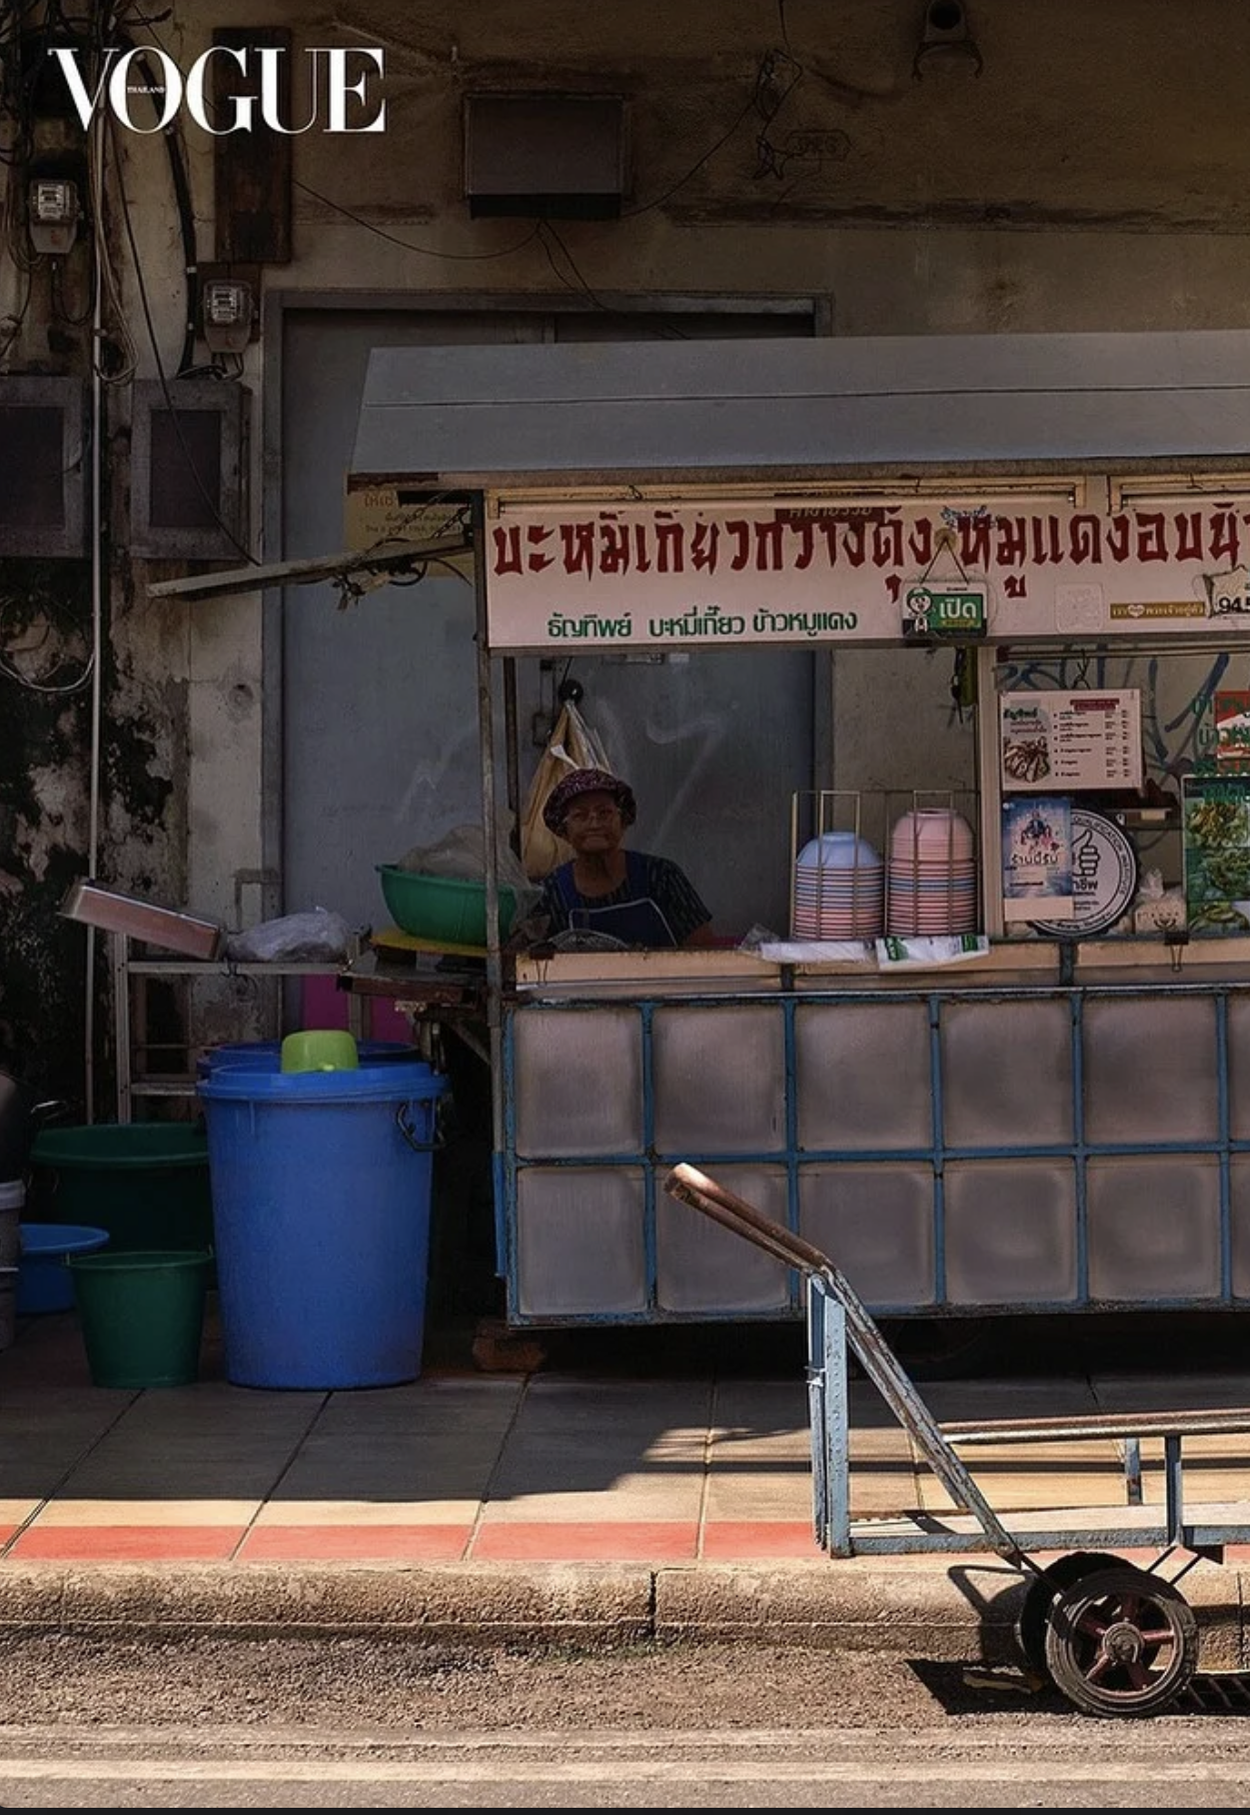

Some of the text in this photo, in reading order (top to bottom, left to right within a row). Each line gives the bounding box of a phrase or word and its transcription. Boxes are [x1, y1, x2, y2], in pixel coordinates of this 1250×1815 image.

[547, 605, 858, 638] ธัญทิพย์ บะหมี่เกี๊ยว ข้าวหมูแดง
[940, 598, 977, 619] เปิด
